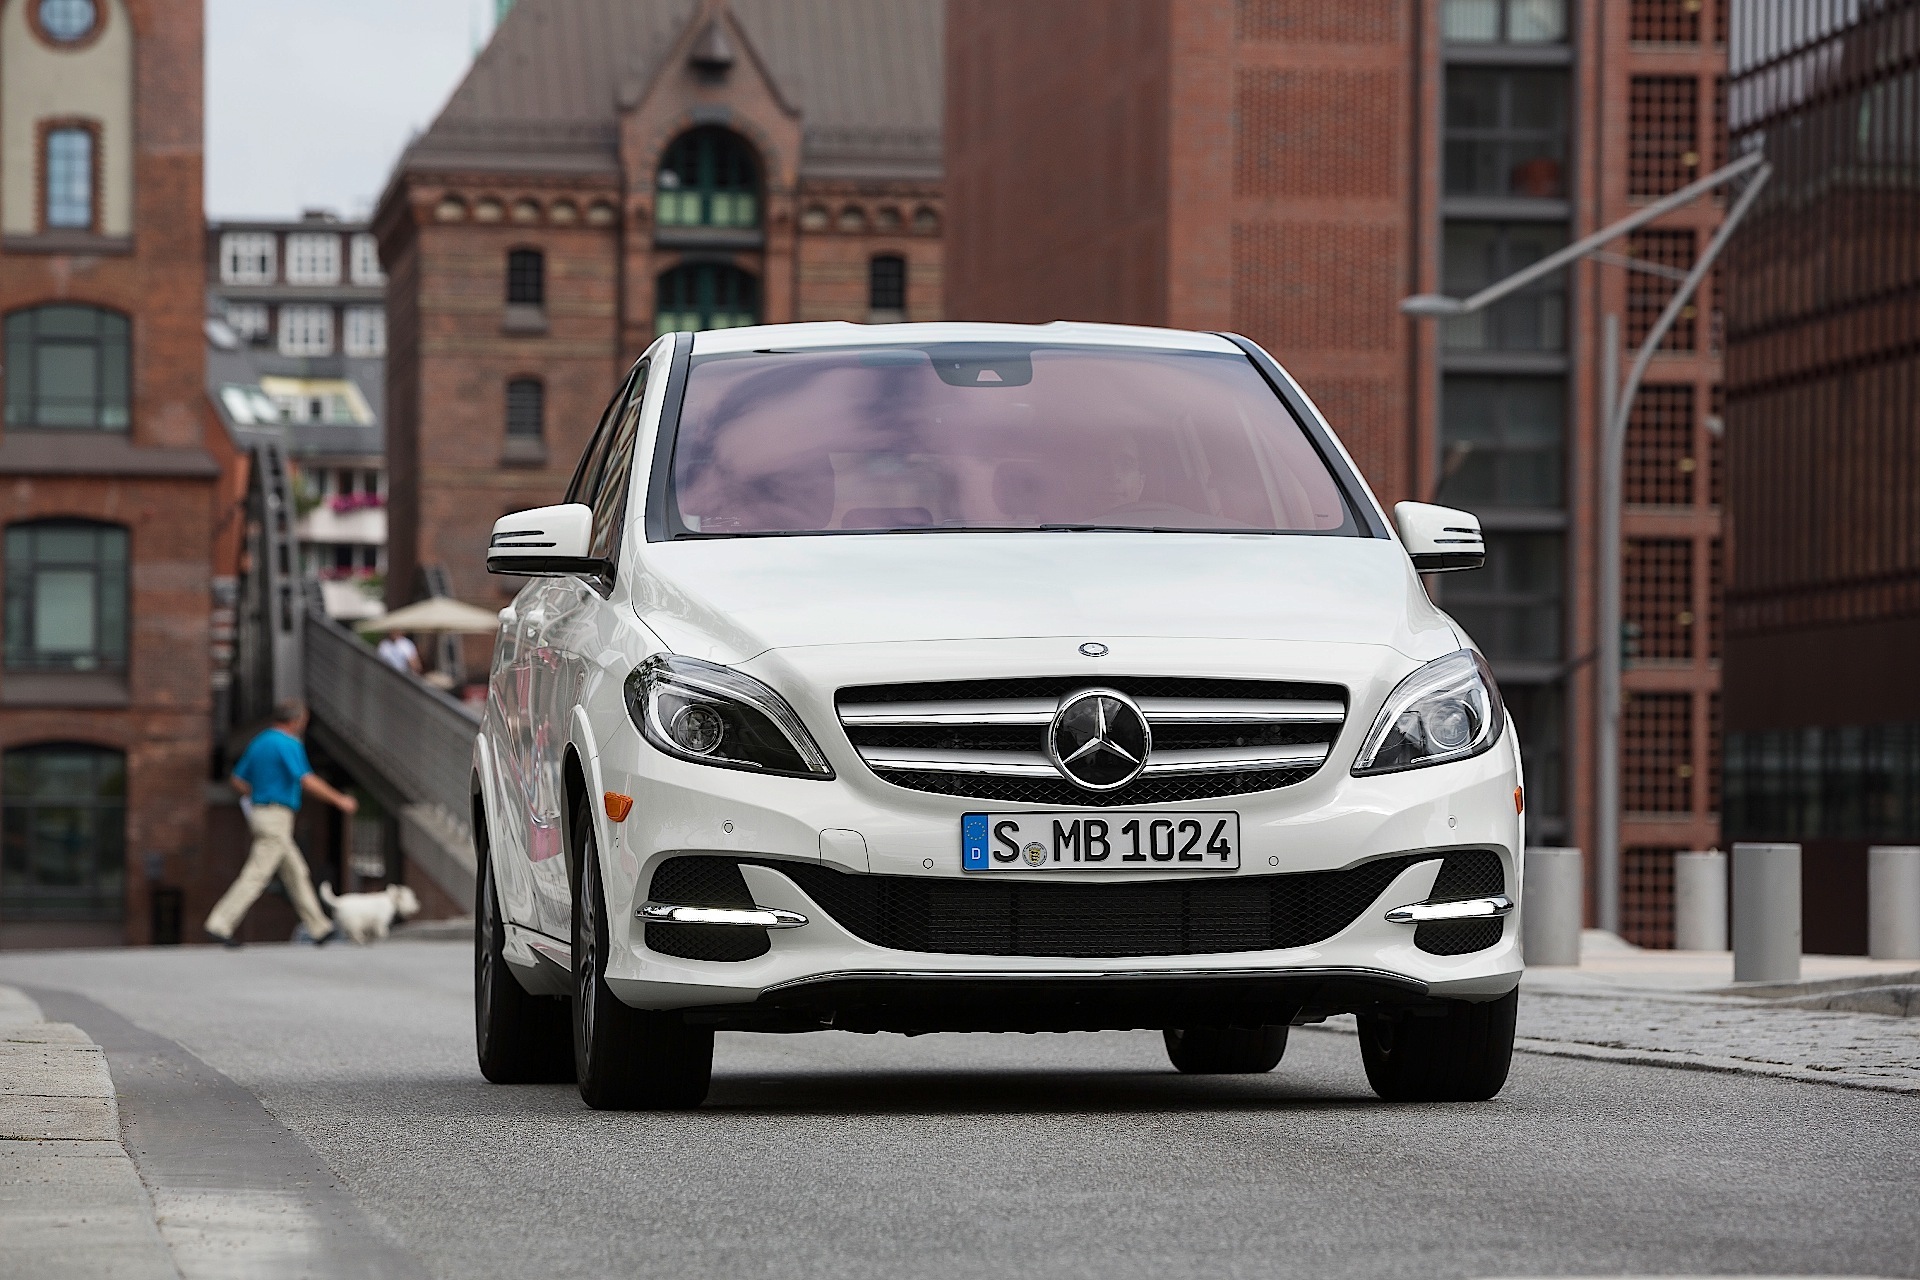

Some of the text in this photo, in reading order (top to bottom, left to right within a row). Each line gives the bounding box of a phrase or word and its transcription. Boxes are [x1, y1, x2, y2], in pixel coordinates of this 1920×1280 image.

[971, 847, 981, 860] D
[993, 820, 1020, 863] S
[1053, 820, 1111, 862] MB
[1122, 819, 1231, 862] 1024
